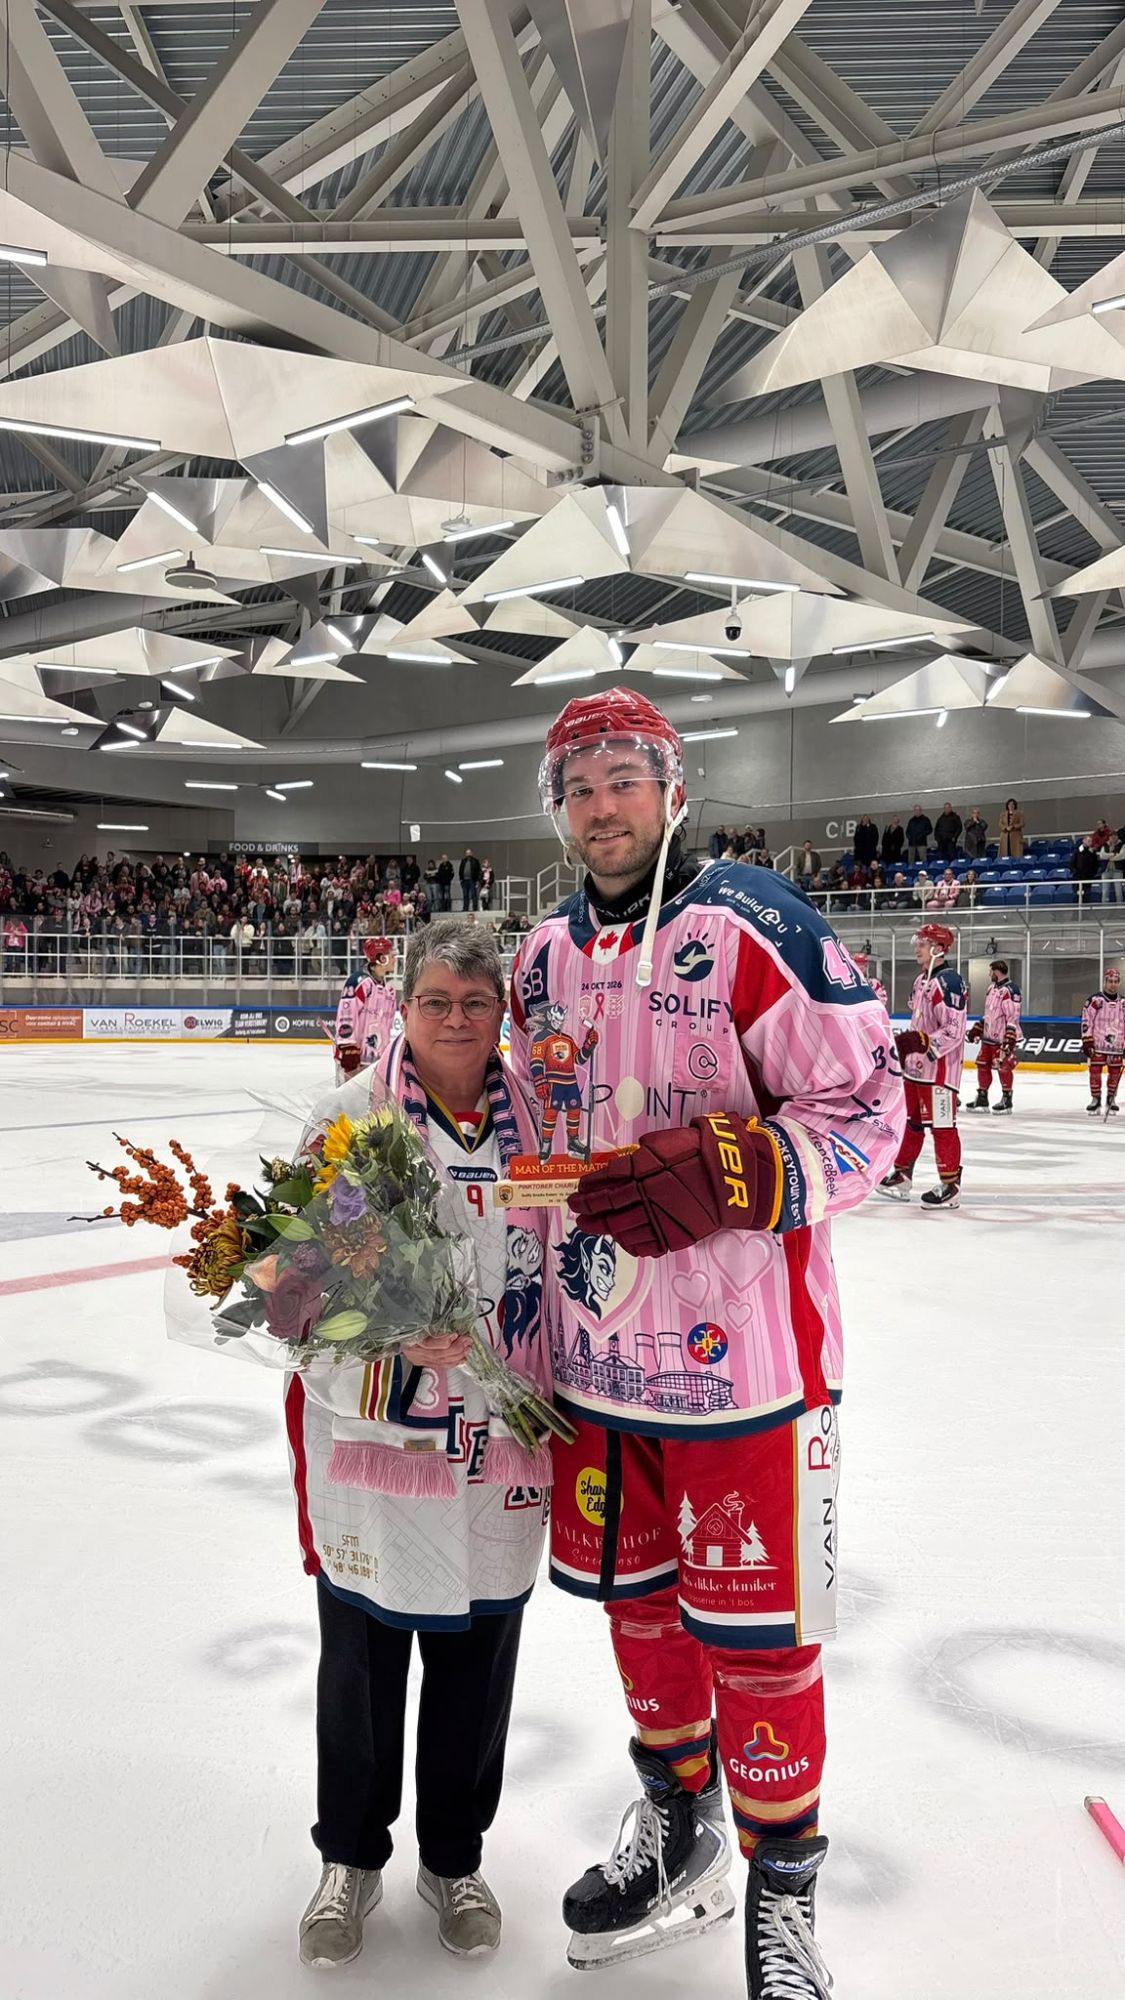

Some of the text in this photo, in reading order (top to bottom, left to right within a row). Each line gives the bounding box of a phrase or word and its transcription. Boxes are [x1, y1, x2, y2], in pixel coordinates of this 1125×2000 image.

[229, 843, 298, 852] FOOD & DRINKS
[718, 886, 734, 896] We
[735, 891, 763, 913] Build
[777, 923, 788, 933] U
[648, 991, 734, 1023] SOLIFY
[91, 1012, 176, 1027] VAN ROEKEL
[656, 1019, 729, 1034] GROUP
[1016, 1037, 1084, 1055] AUE
[515, 1162, 608, 1174] MAN OF THE MATC
[704, 1112, 749, 1208] UER
[458, 1171, 496, 1180] BAUER
[467, 1185, 483, 1217] 9
[580, 1475, 607, 1496] Shar
[586, 1497, 607, 1518] Edg
[556, 1520, 661, 1549] VALKEHOF
[822, 1498, 834, 1590] VAN
[694, 1577, 723, 1592] dikke
[727, 1577, 777, 1592] daniker
[738, 1598, 754, 1606] bos
[626, 1694, 660, 1711] NIUS
[729, 1756, 810, 1782] GEONIUS
